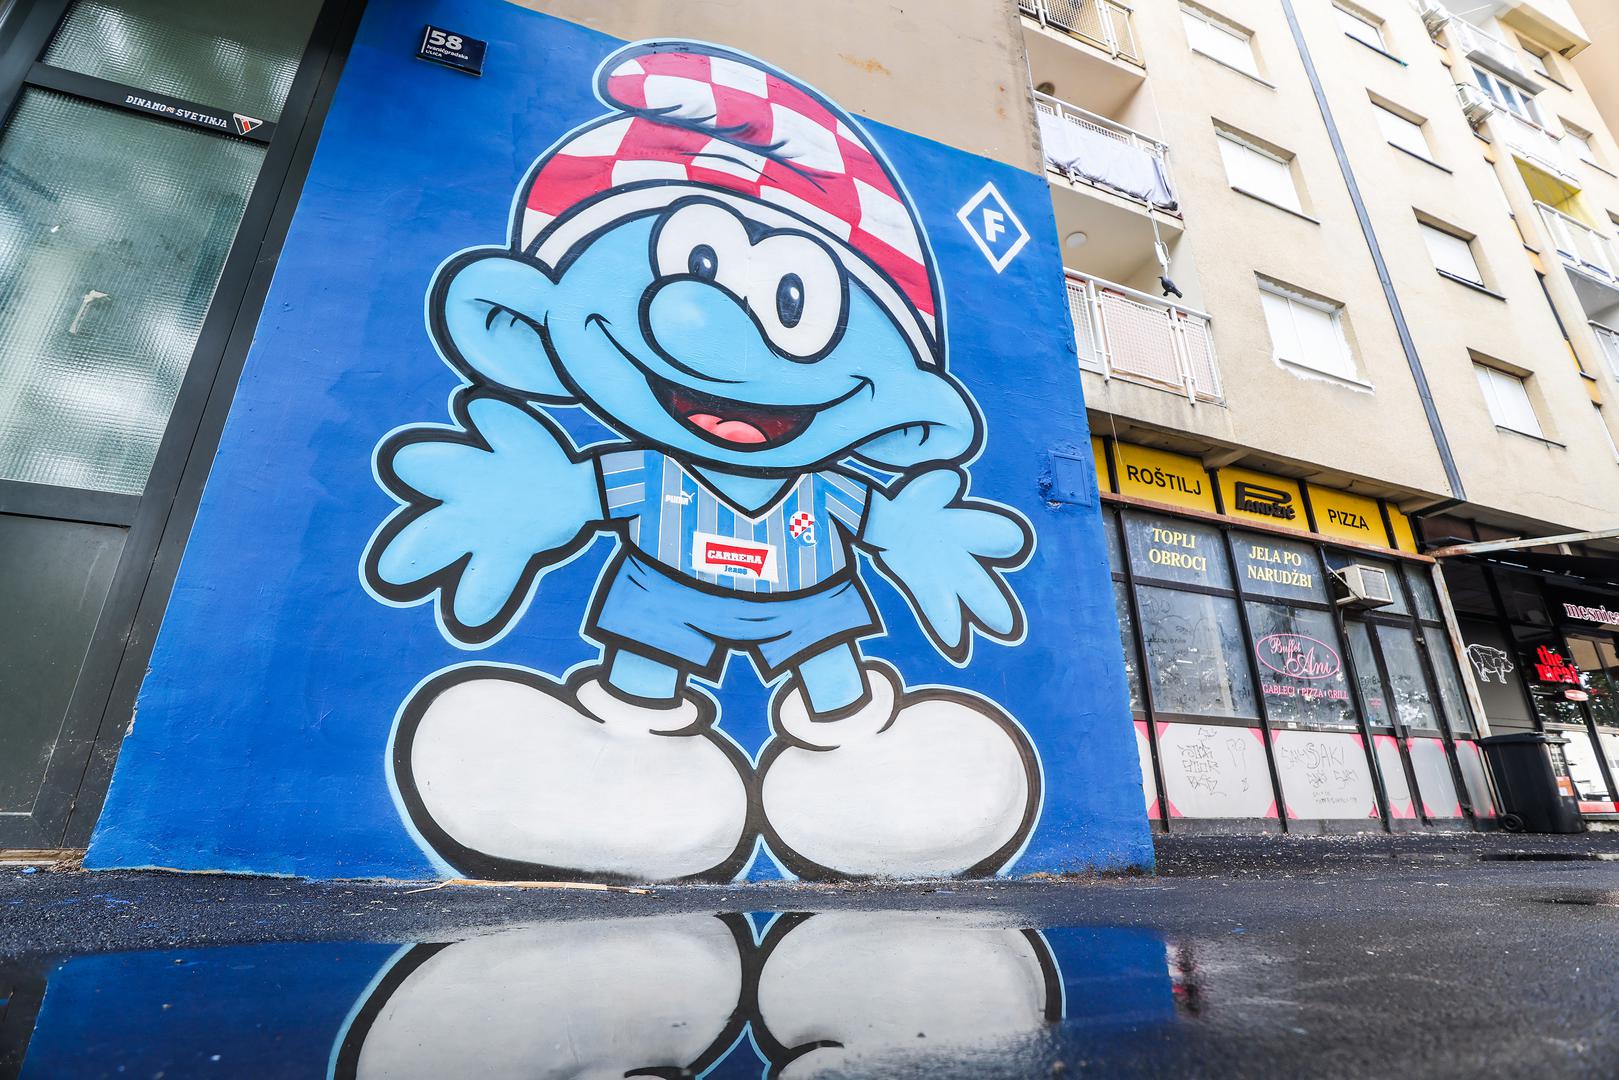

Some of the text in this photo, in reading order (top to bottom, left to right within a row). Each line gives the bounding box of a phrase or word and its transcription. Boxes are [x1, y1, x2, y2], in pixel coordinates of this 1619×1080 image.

[429, 30, 463, 50] 58
[125, 95, 228, 128] DINAMO SVETINJA
[982, 207, 1006, 242] F
[1126, 464, 1202, 495] ROŠTILJ
[665, 494, 689, 506] PUMA
[1327, 508, 1370, 531] PIZZA
[1152, 527, 1196, 549] TOPLI
[707, 549, 763, 565] CARRERA
[1148, 548, 1207, 572] OBROCI
[1249, 545, 1302, 567] JELA PO
[724, 564, 748, 576] Jeans
[1247, 564, 1313, 588] NARUDŽBI
[1269, 637, 1302, 659] Buffet
[1536, 645, 1564, 668] the
[1286, 646, 1332, 676] Ani
[1535, 663, 1581, 684] meat
[1262, 683, 1350, 700] GABLECI PIZZA GRILL
